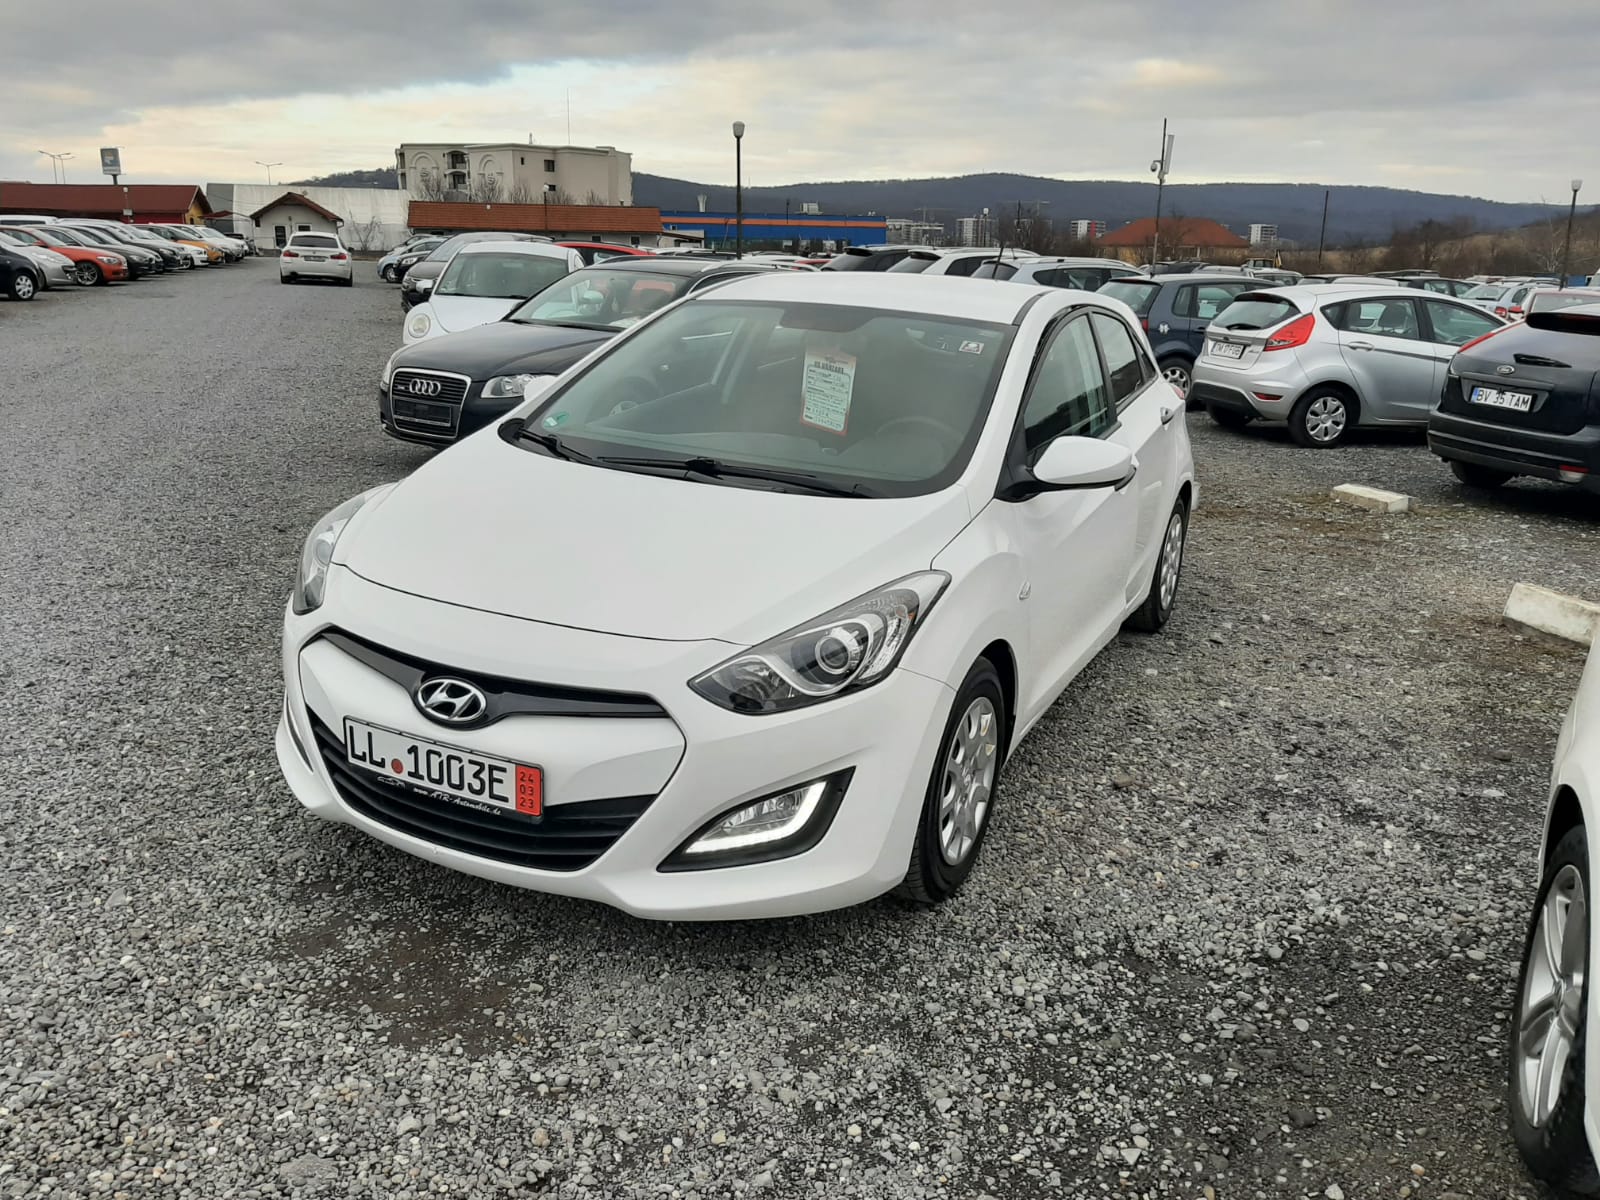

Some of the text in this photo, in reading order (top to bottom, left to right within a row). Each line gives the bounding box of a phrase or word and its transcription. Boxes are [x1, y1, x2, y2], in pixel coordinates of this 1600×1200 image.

[1477, 389, 1530, 409] BV 35 TAM
[349, 725, 509, 804] LL 1003E
[519, 771, 534, 784] 24
[519, 784, 534, 796] 03
[519, 796, 534, 809] 23
